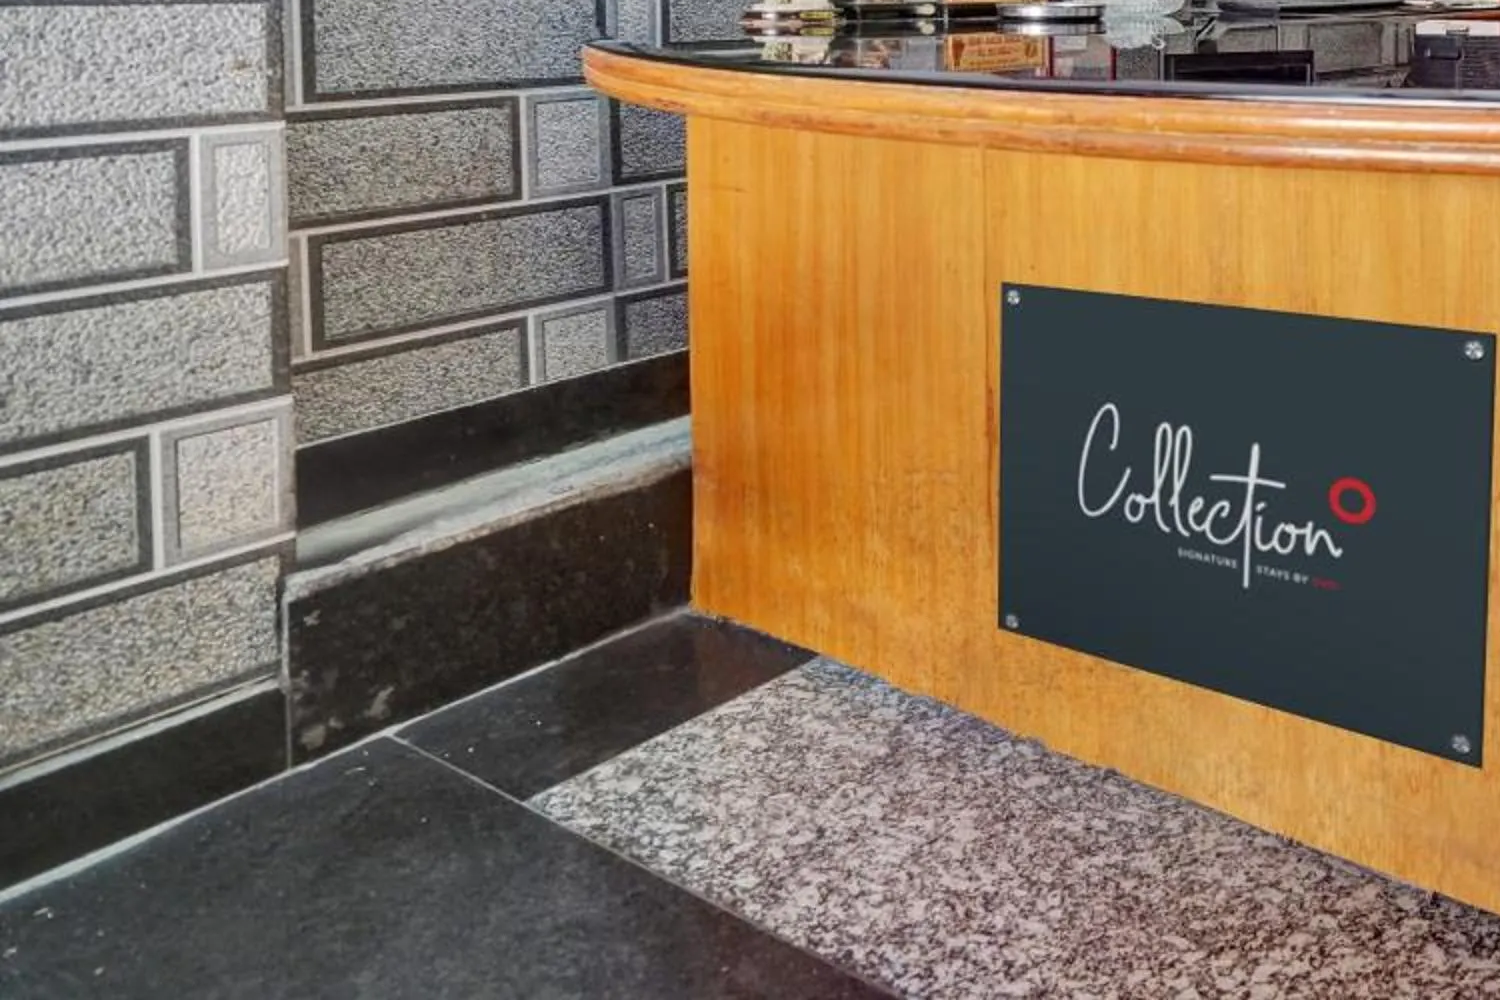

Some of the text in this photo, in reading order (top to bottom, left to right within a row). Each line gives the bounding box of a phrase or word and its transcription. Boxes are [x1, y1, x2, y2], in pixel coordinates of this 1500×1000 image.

[1078, 402, 1343, 588] Collection
[1177, 547, 1238, 569] SIGNATURE
[1255, 565, 1290, 581] STAYS
